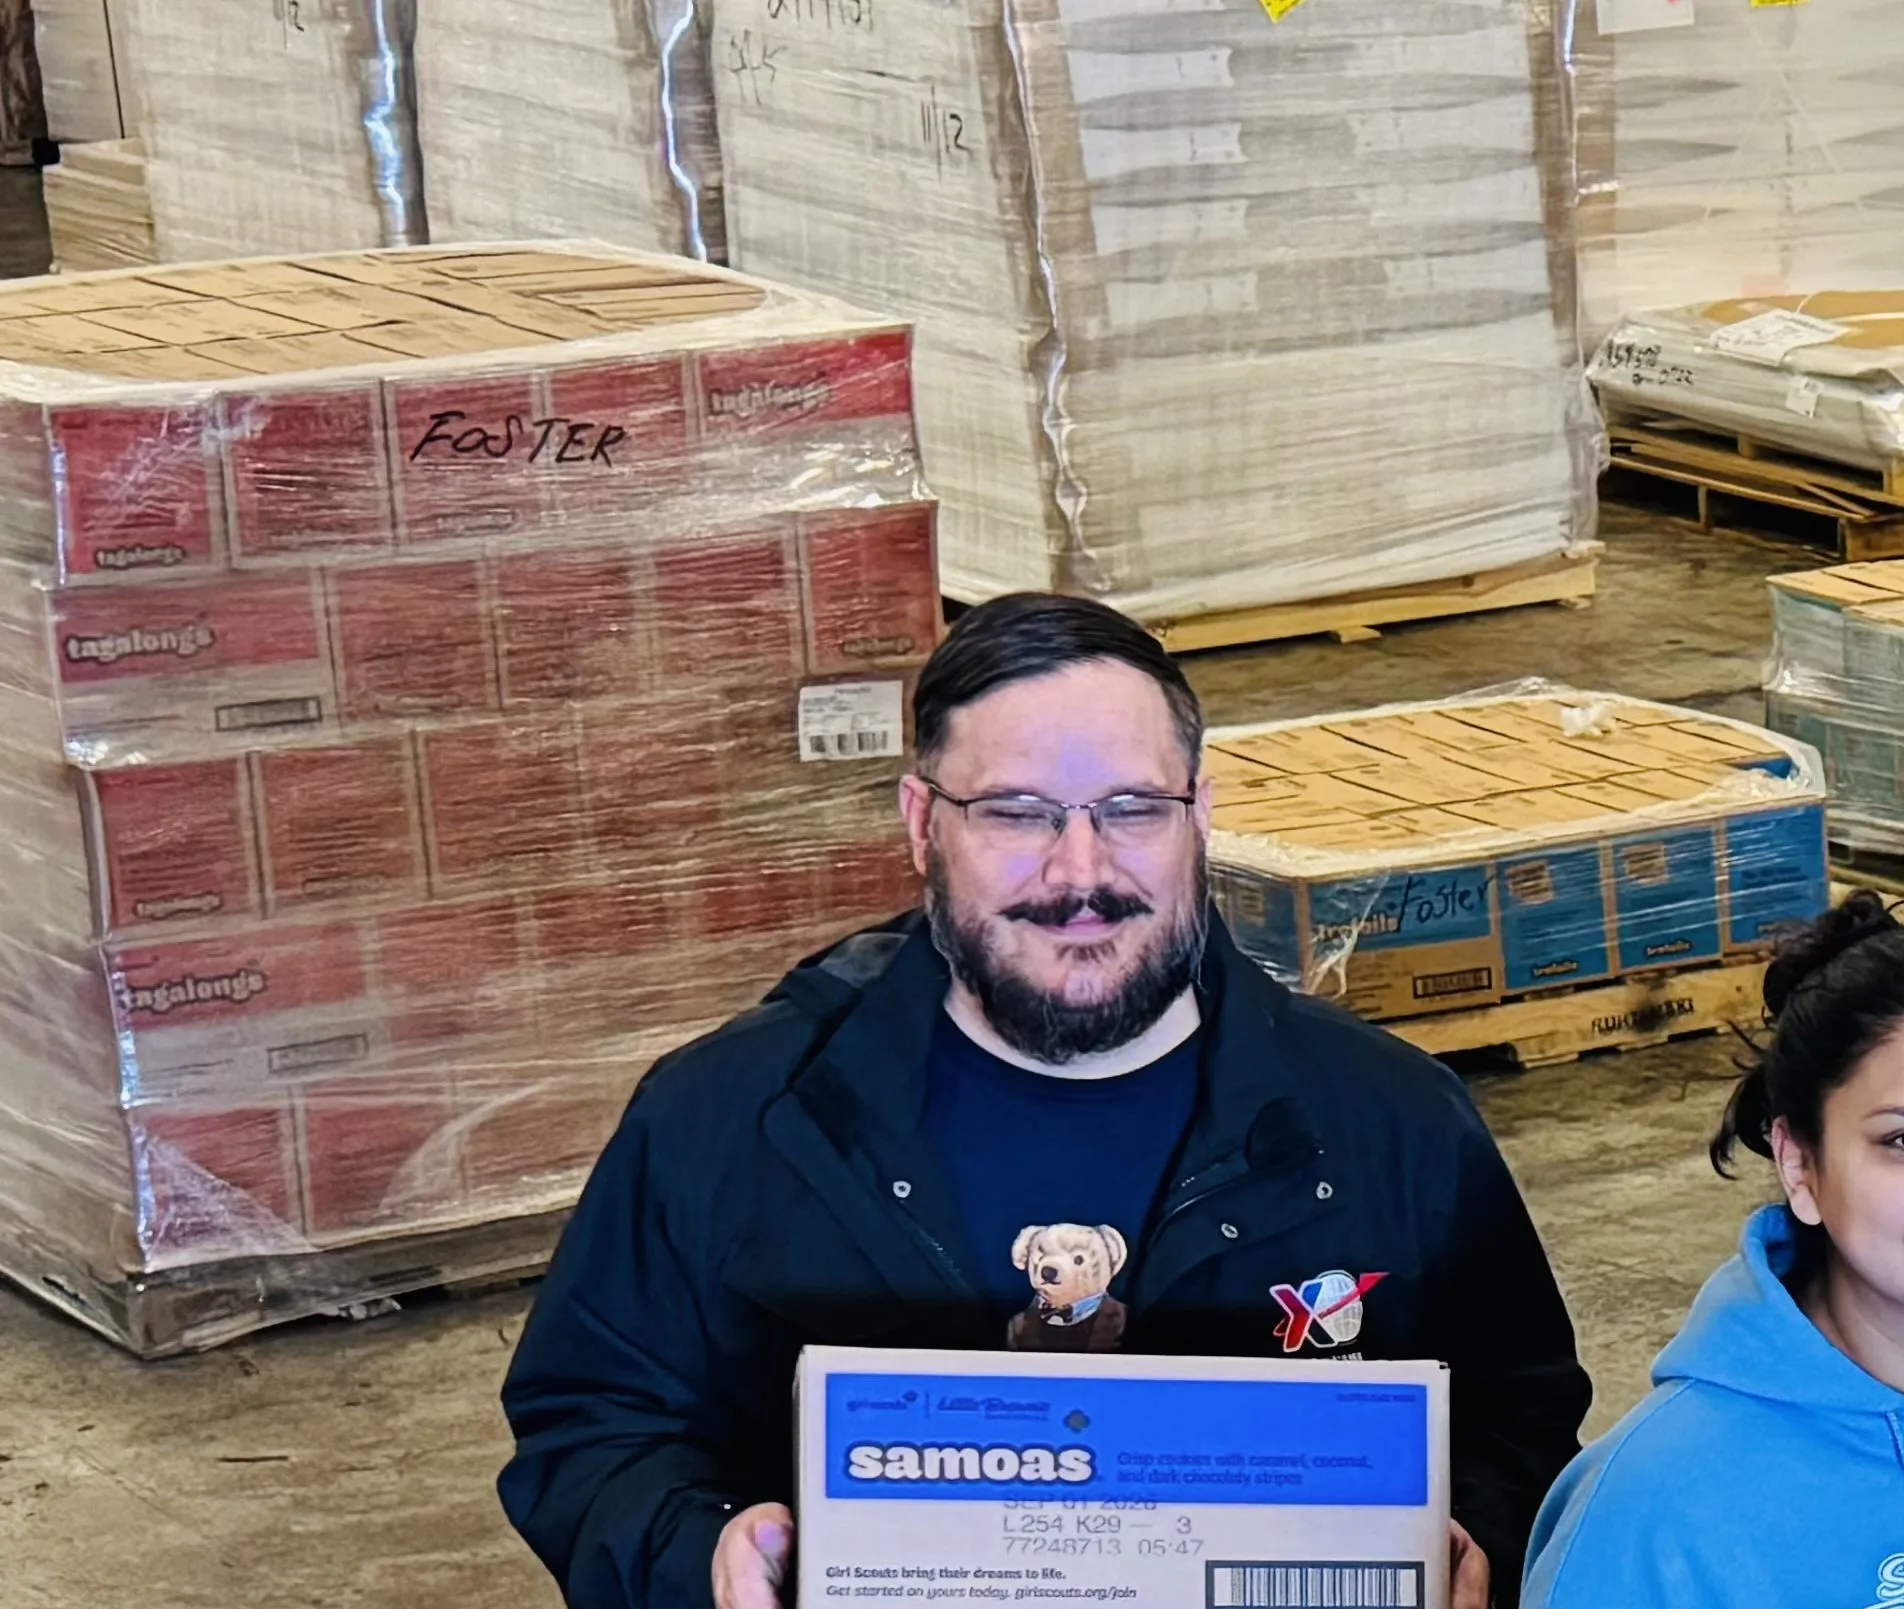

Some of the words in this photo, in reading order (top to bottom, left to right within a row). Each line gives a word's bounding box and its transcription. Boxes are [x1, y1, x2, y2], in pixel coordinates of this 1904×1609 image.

[410, 410, 631, 468] FOSTER
[62, 622, 215, 666] tagalongs
[1399, 873, 1498, 923] Foster
[847, 1444, 1094, 1483] samoas
[1117, 1451, 1155, 1467] Crisp
[1157, 1452, 1210, 1466] cookies
[1215, 1453, 1245, 1466] with
[1117, 1469, 1144, 1483] and
[1150, 1469, 1181, 1483] dark
[1254, 1470, 1303, 1487] stripes
[1076, 1515, 1121, 1533] K29
[1176, 1516, 1192, 1534] 3
[1002, 1537, 1121, 1555] 77248713
[1137, 1538, 1204, 1556] 05:47
[826, 1566, 851, 1579] Girl
[854, 1567, 899, 1579] Scouts
[901, 1567, 936, 1581] bring
[939, 1567, 970, 1579] their
[973, 1568, 1022, 1580] dreams
[1025, 1569, 1040, 1580] to
[1042, 1567, 1067, 1580] life.
[825, 1585, 851, 1597] Get
[854, 1585, 904, 1598] started
[906, 1587, 924, 1598] on
[926, 1588, 967, 1601] yours
[1014, 1586, 1137, 1601] girlscouts.org/join
